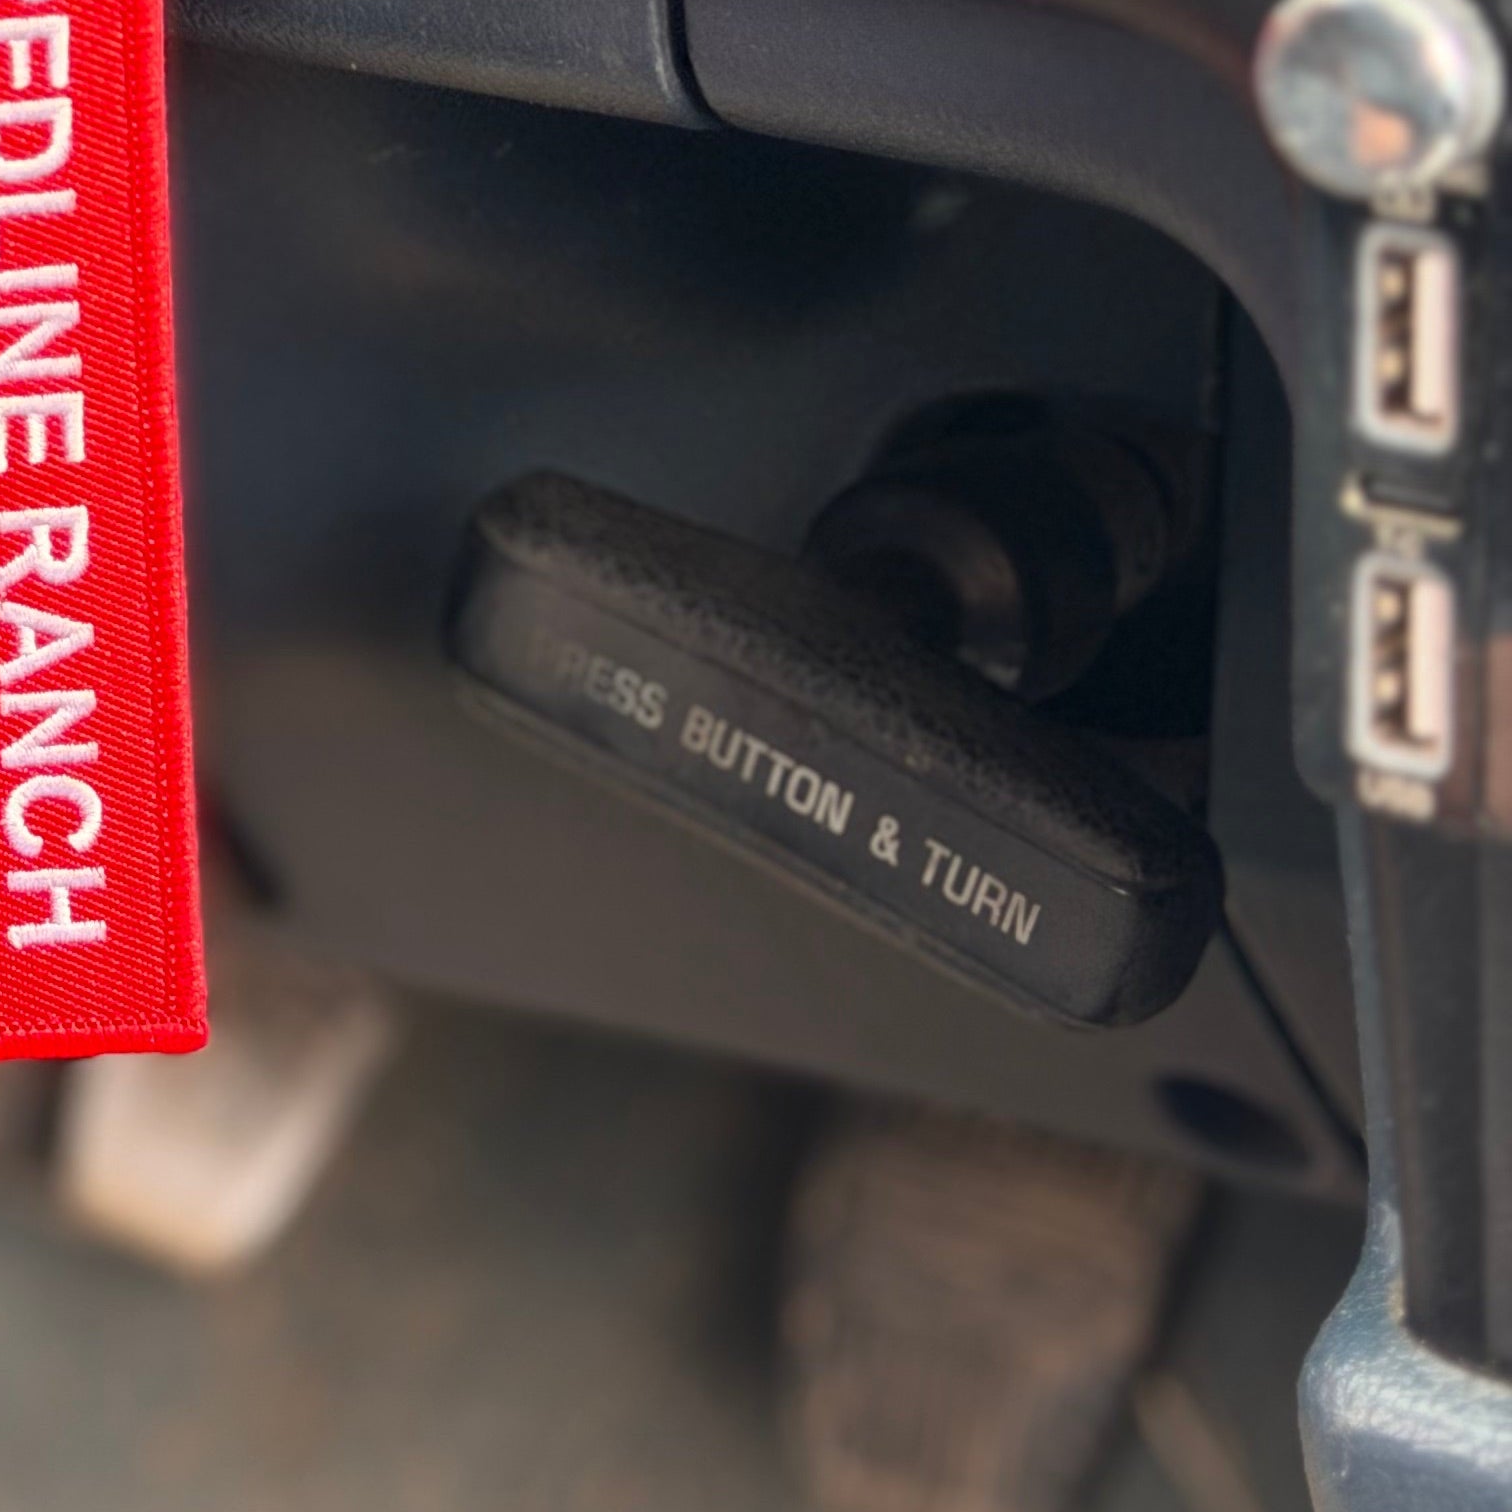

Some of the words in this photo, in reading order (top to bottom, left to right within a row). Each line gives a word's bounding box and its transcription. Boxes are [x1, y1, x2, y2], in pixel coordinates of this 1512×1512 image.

[679, 703, 855, 836] BUTTON
[868, 814, 902, 867] &
[920, 838, 1042, 946] TURN
